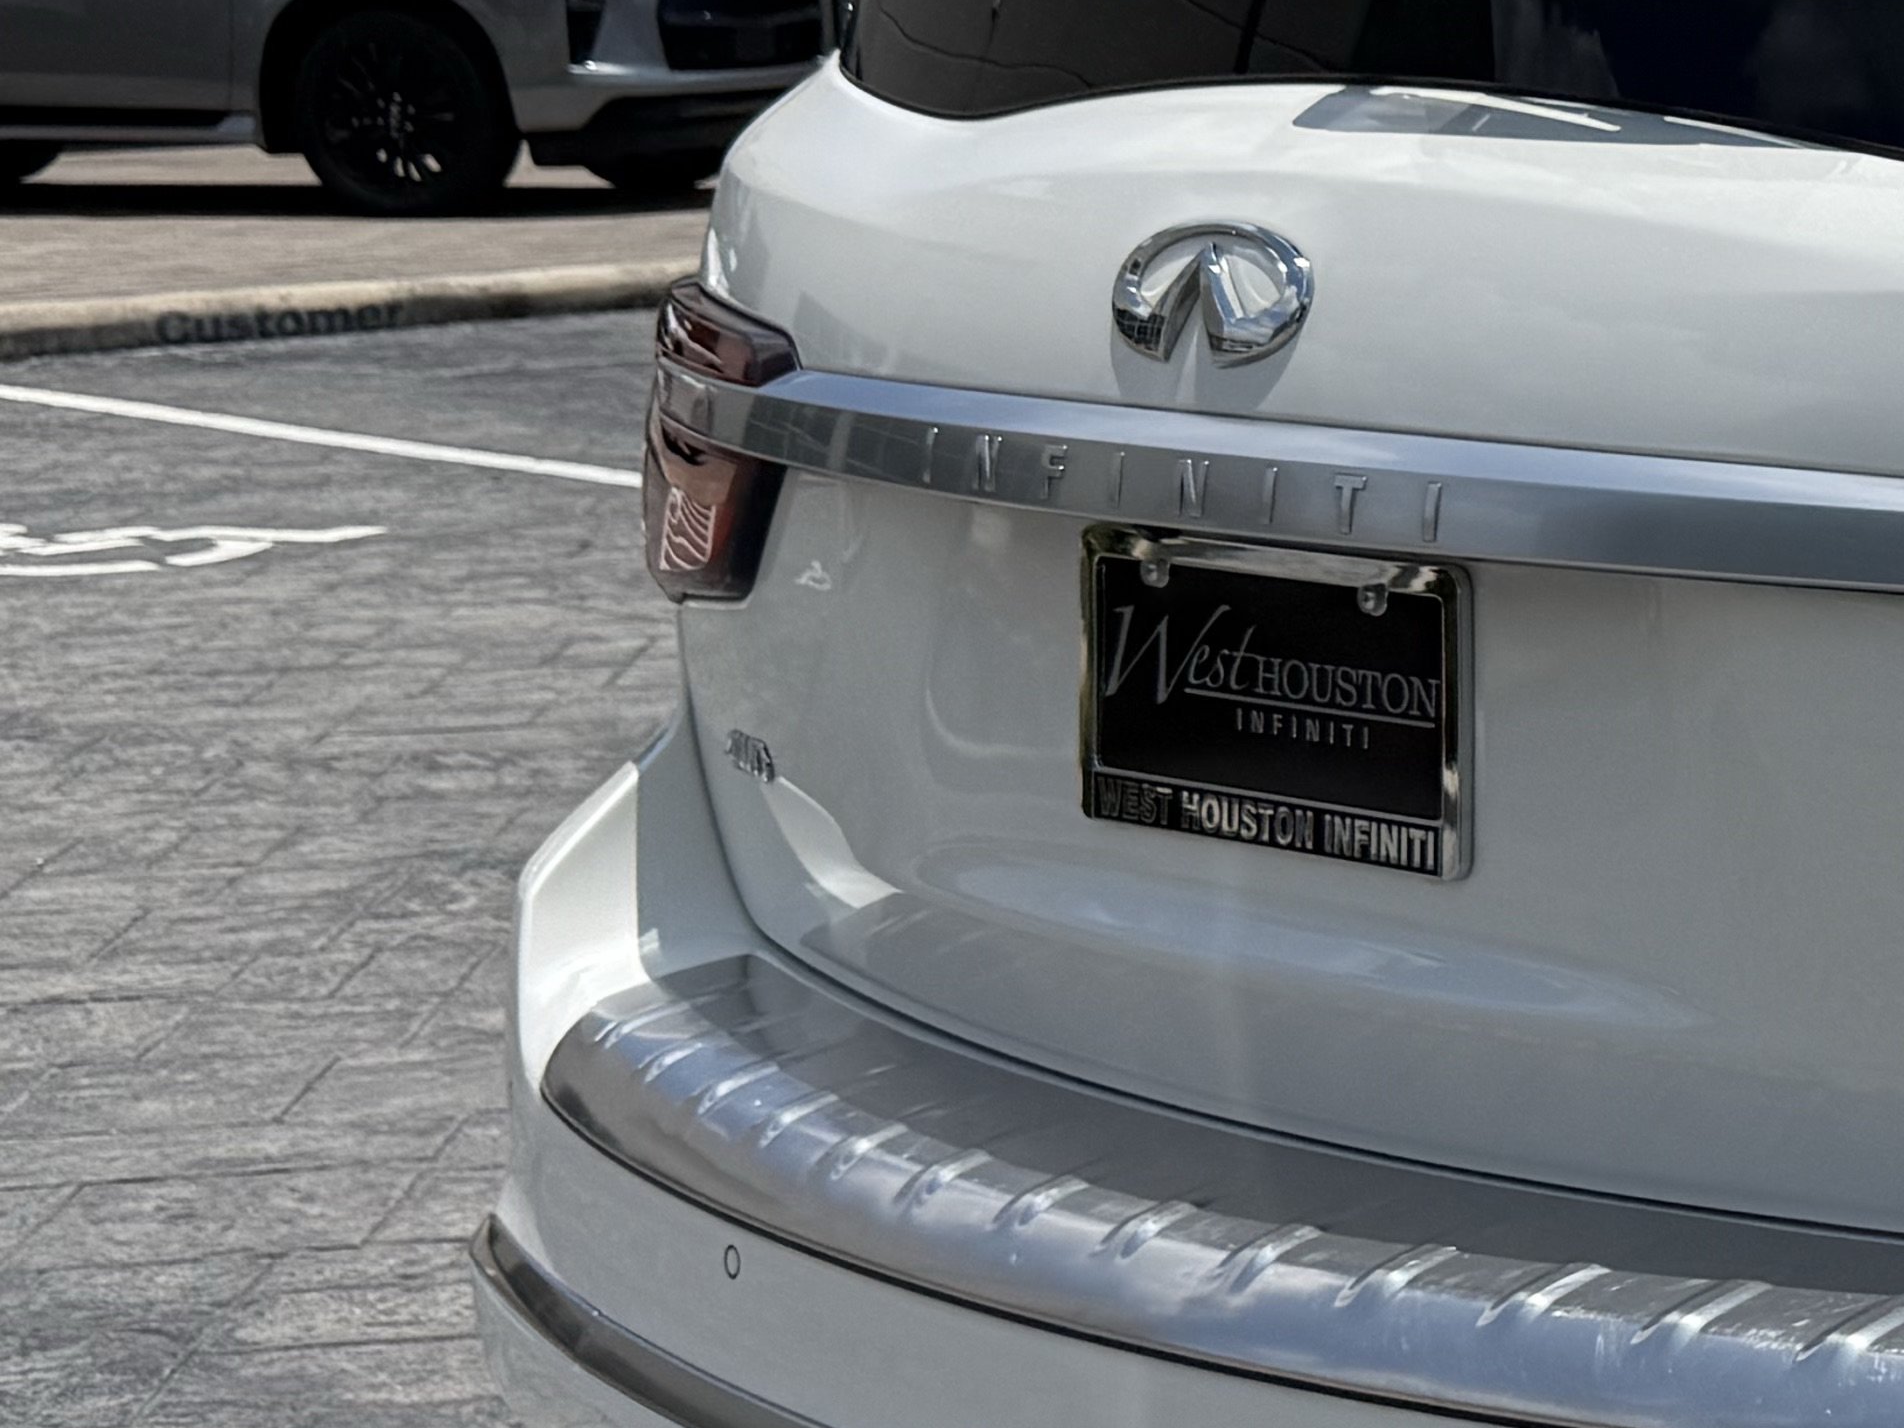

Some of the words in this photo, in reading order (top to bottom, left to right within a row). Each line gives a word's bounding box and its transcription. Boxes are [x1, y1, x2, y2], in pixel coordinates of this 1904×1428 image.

[922, 426, 1443, 543] INFINITI
[1104, 603, 1257, 705] West
[1256, 656, 1440, 719] HOUSTON
[1235, 707, 1370, 750] INFINITI
[1097, 775, 1174, 826] WEST
[1181, 790, 1314, 850] HOUSTON
[1323, 813, 1437, 871] INFINITI
